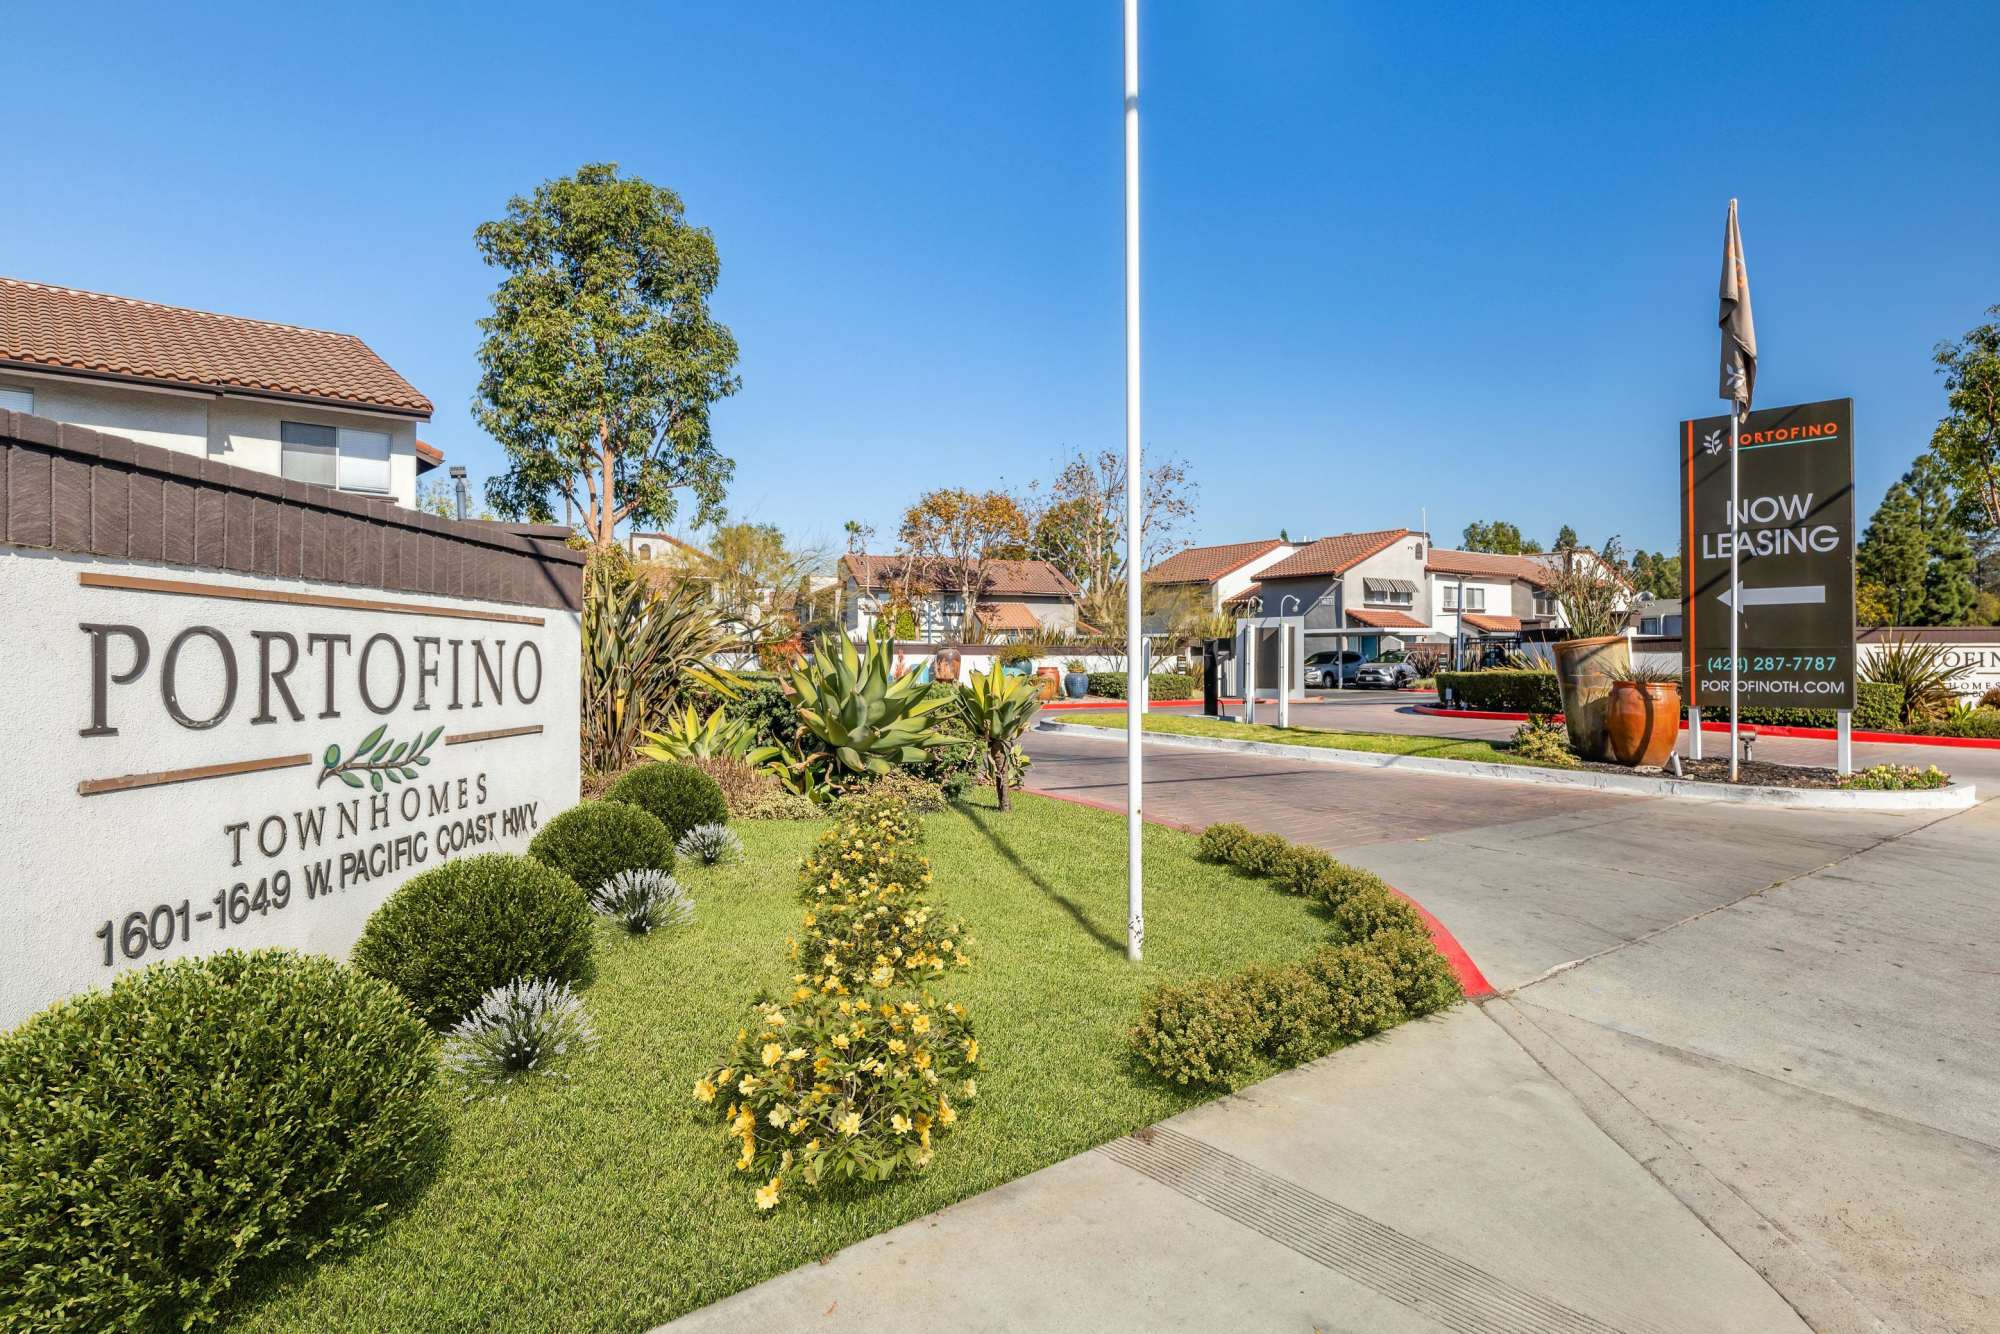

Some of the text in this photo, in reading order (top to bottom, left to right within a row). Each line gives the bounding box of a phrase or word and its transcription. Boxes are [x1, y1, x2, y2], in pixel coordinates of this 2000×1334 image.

[1726, 493, 1814, 525] NOW
[1702, 525, 1840, 559] LEASING
[79, 622, 544, 738] PORTOFINO
[1753, 656, 1837, 671] 287-7787
[224, 773, 488, 867] TOWNHOMES
[97, 870, 291, 966] 1601-1649
[304, 858, 333, 899] W.
[339, 831, 428, 889] PACIFIC
[436, 812, 497, 856] COAST
